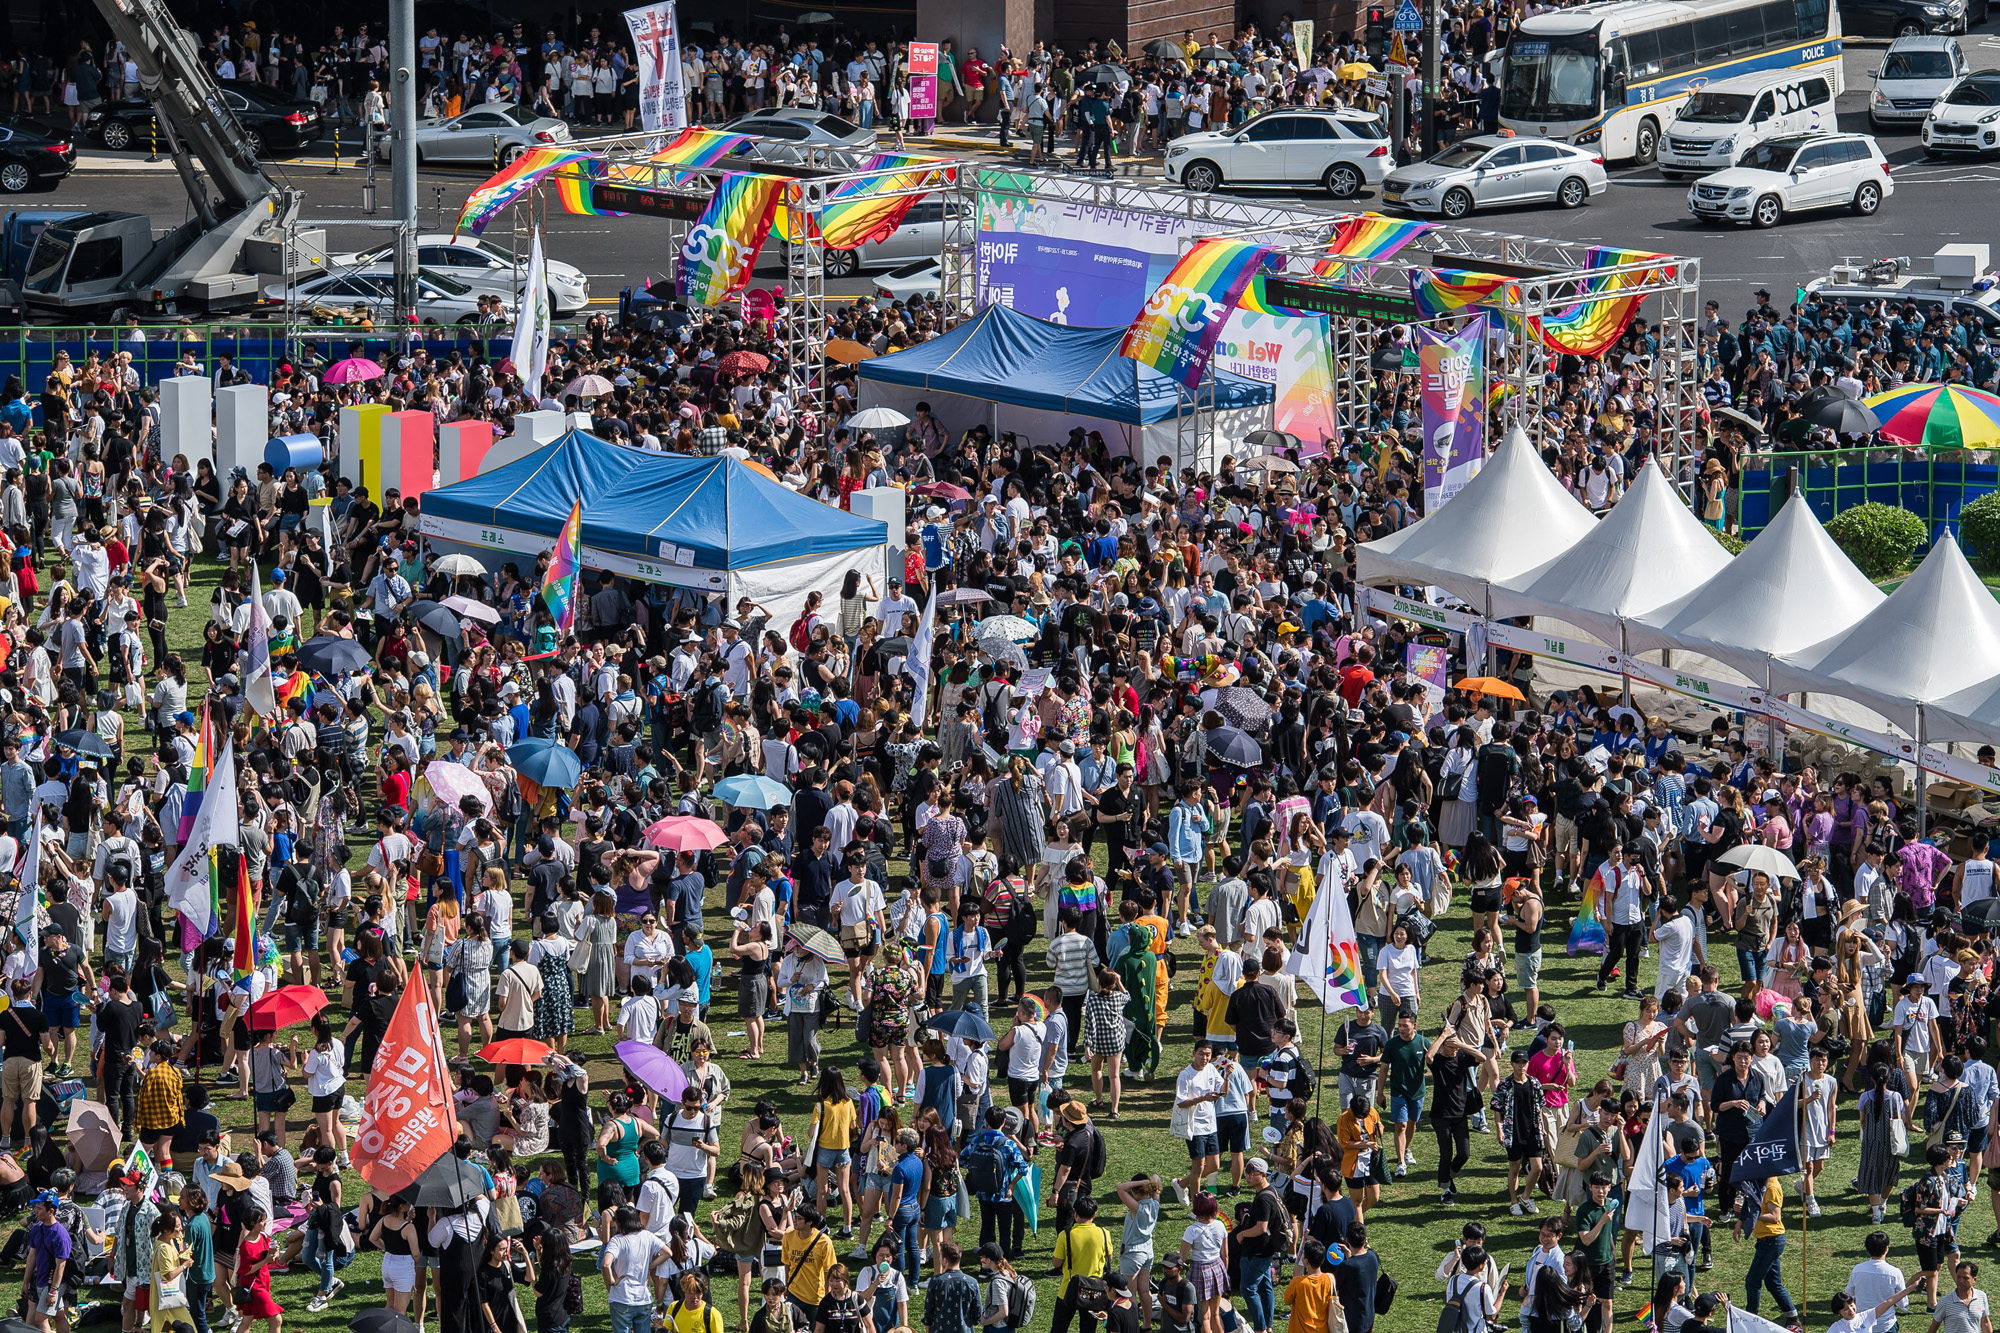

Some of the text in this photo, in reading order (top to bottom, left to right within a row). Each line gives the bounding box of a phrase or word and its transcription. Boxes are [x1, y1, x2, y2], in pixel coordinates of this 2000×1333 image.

[913, 54, 934, 62] STOP
[1802, 46, 1825, 61] POLICE
[1128, 328, 1201, 368] 서울퀴어문화축제
[1164, 326, 1185, 343] Culture
[1185, 337, 1207, 356] Festival
[481, 529, 505, 545] 프레스
[637, 562, 662, 577] 프레스
[1393, 599, 1410, 613] 2018
[1409, 604, 1434, 619] 프라이드
[1543, 638, 1565, 655] 기념품
[1675, 674, 1710, 694] 공식 기념품
